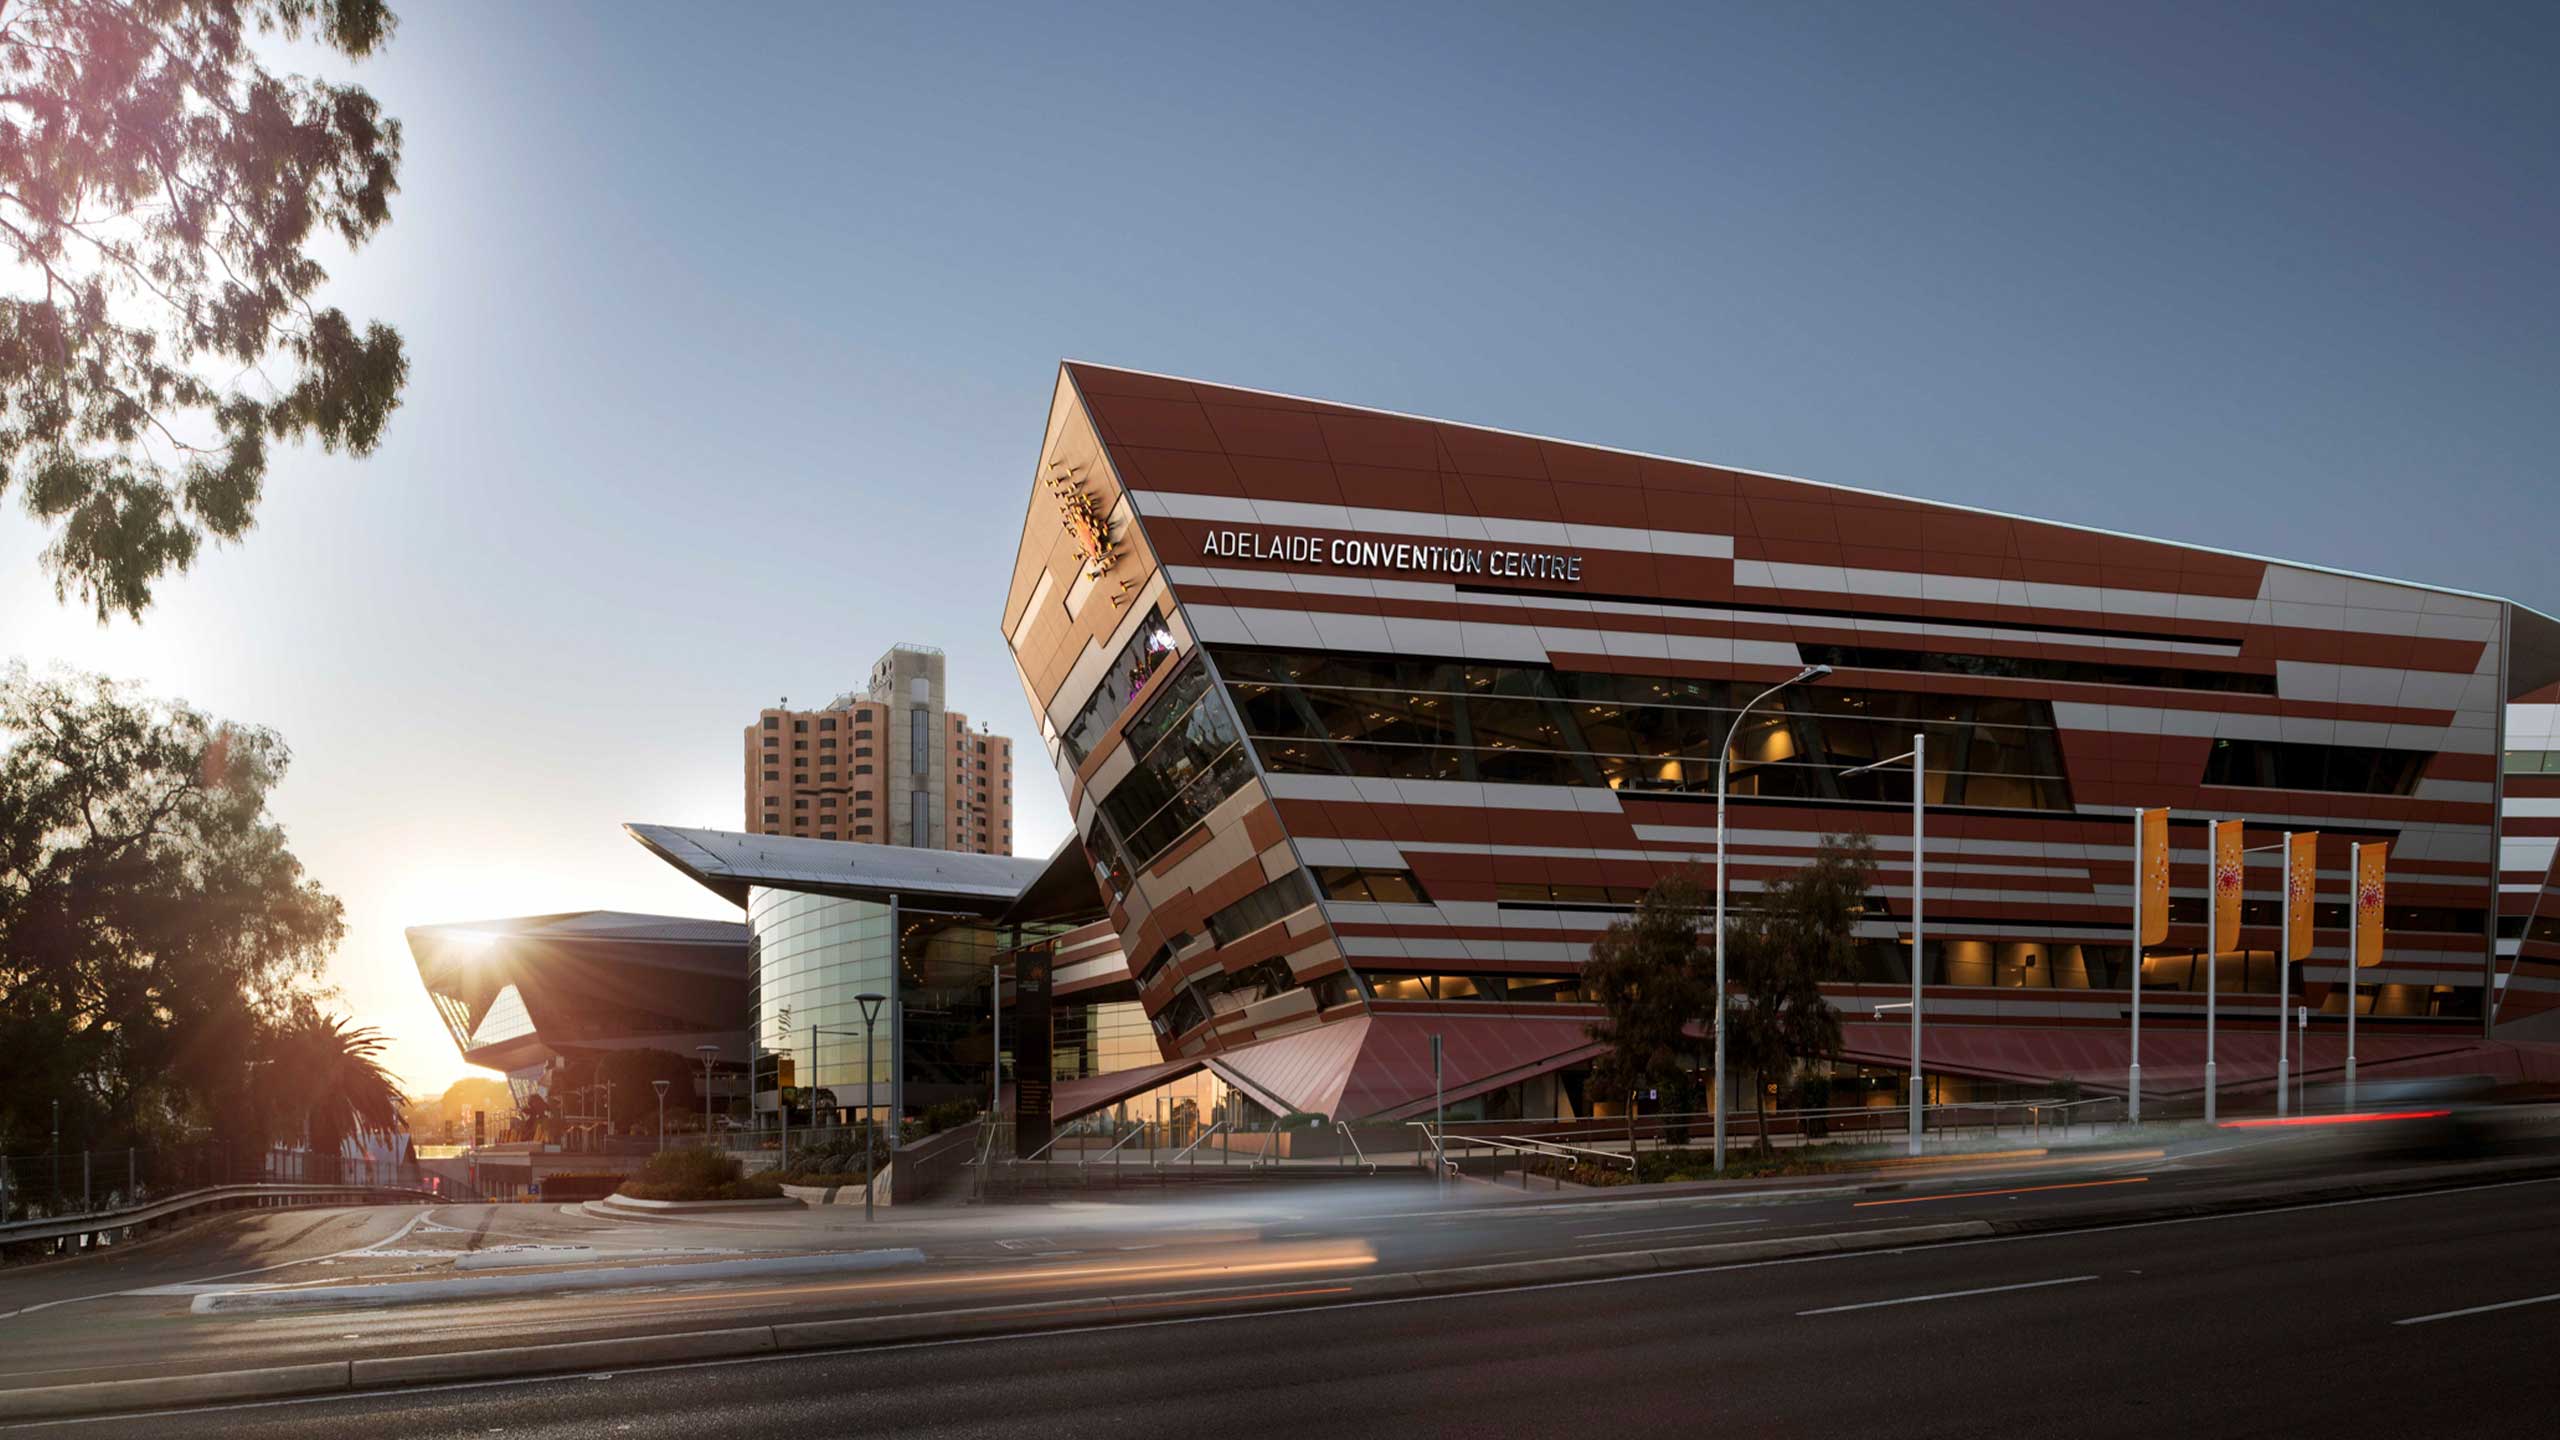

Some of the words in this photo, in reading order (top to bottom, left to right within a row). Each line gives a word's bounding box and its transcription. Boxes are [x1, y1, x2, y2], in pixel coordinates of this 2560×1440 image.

[1203, 530, 1324, 563] ADELAIDE
[1331, 539, 1482, 574] CONVENTION
[1490, 551, 1582, 582] CENTRE
